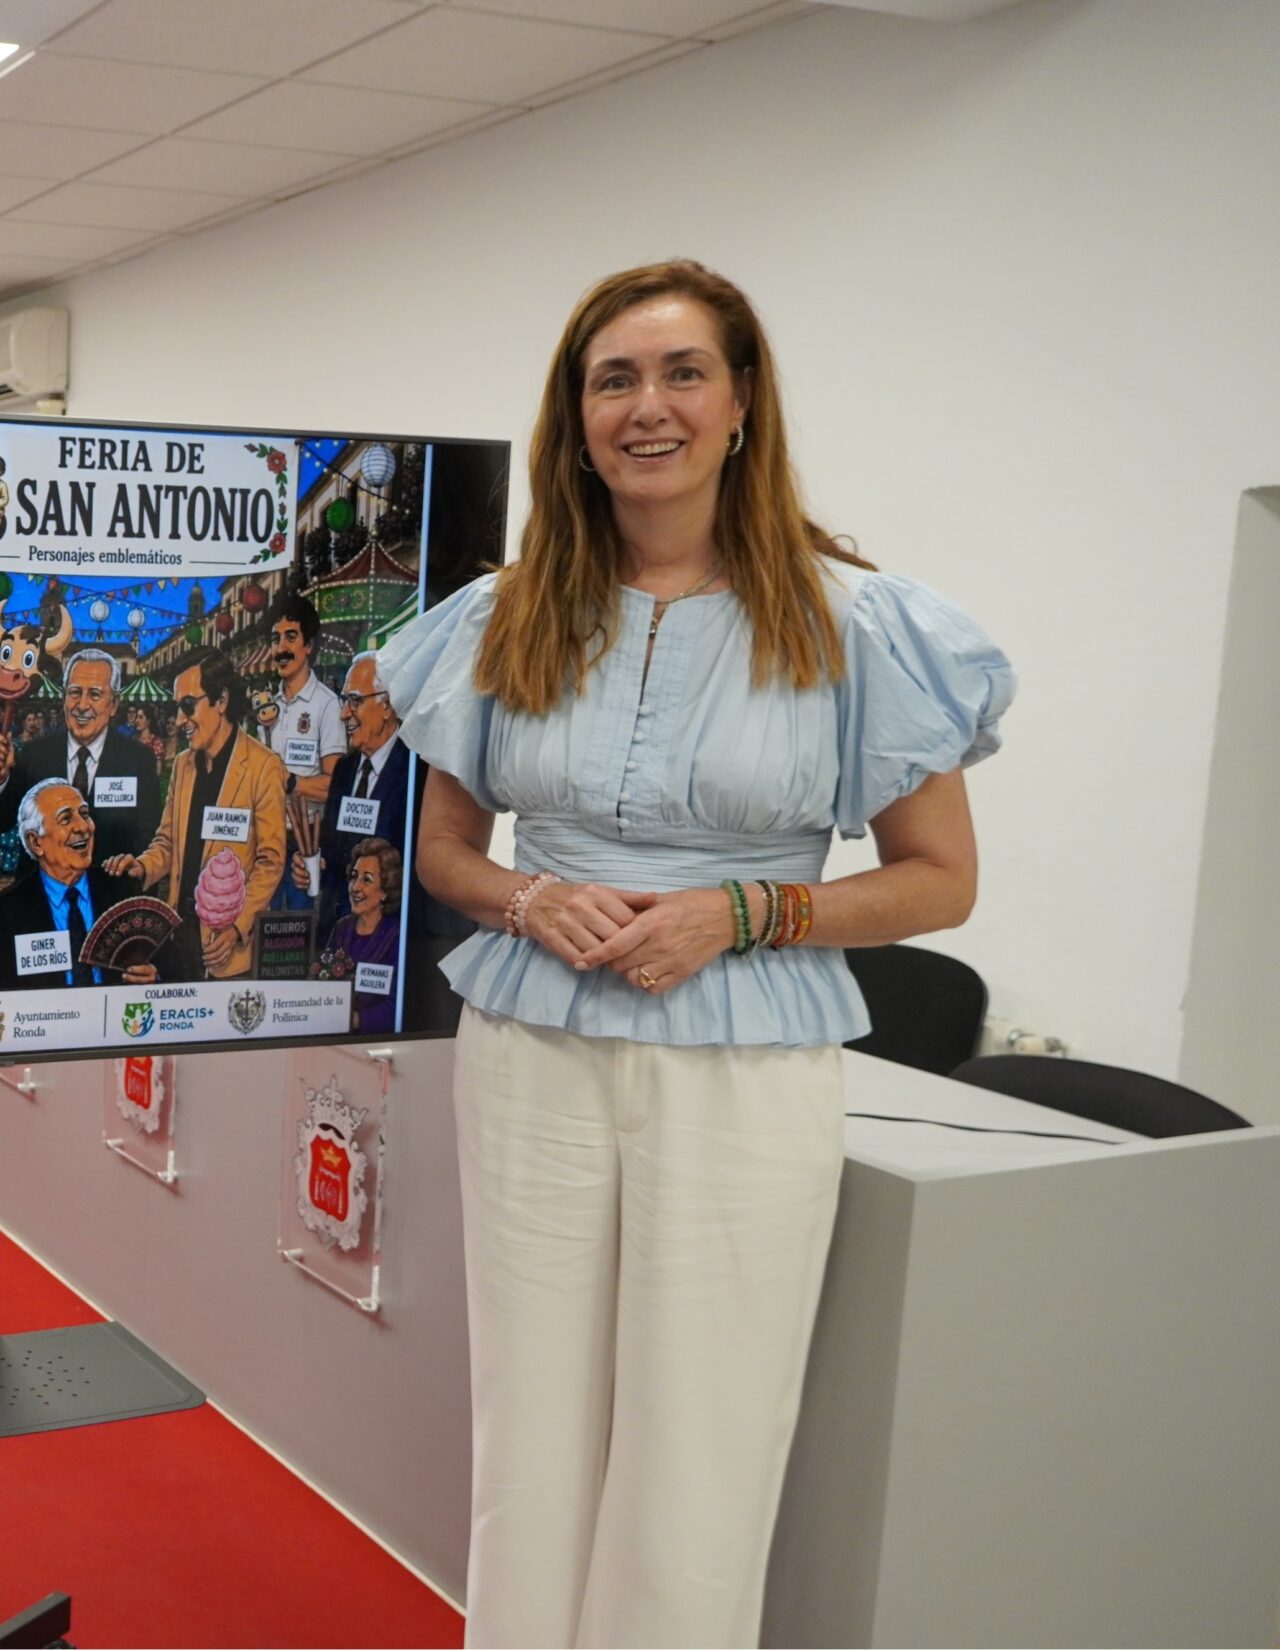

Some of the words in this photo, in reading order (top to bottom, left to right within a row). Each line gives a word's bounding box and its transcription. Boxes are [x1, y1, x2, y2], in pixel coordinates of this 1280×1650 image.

[58, 436, 153, 472] FERIA
[164, 442, 205, 474] DE
[16, 478, 96, 537] SAN
[107, 483, 275, 543] ANTONIO
[28, 545, 95, 564] Personajes
[98, 548, 183, 566] emblemáticos
[346, 802, 373, 815] DOCTOR
[207, 812, 223, 821] JUAN
[225, 811, 247, 824] RAMÓN
[343, 817, 372, 830] VÁZQUEZ
[212, 824, 239, 837] JIMÉNEZ
[264, 922, 306, 933] CHURROS
[31, 939, 55, 951] GINER
[21, 956, 31, 969] DE
[33, 955, 48, 966] LOS
[49, 952, 68, 964] RÍOS
[261, 966, 305, 977] PALOMITAS
[145, 988, 198, 1000] COLABORAN:
[272, 996, 322, 1009] Hermandad
[324, 996, 334, 1006] de
[336, 995, 344, 1006] la
[13, 1009, 80, 1024] Ayuntamiento
[13, 1026, 46, 1039] Ronda
[160, 1021, 194, 1031] RONDA
